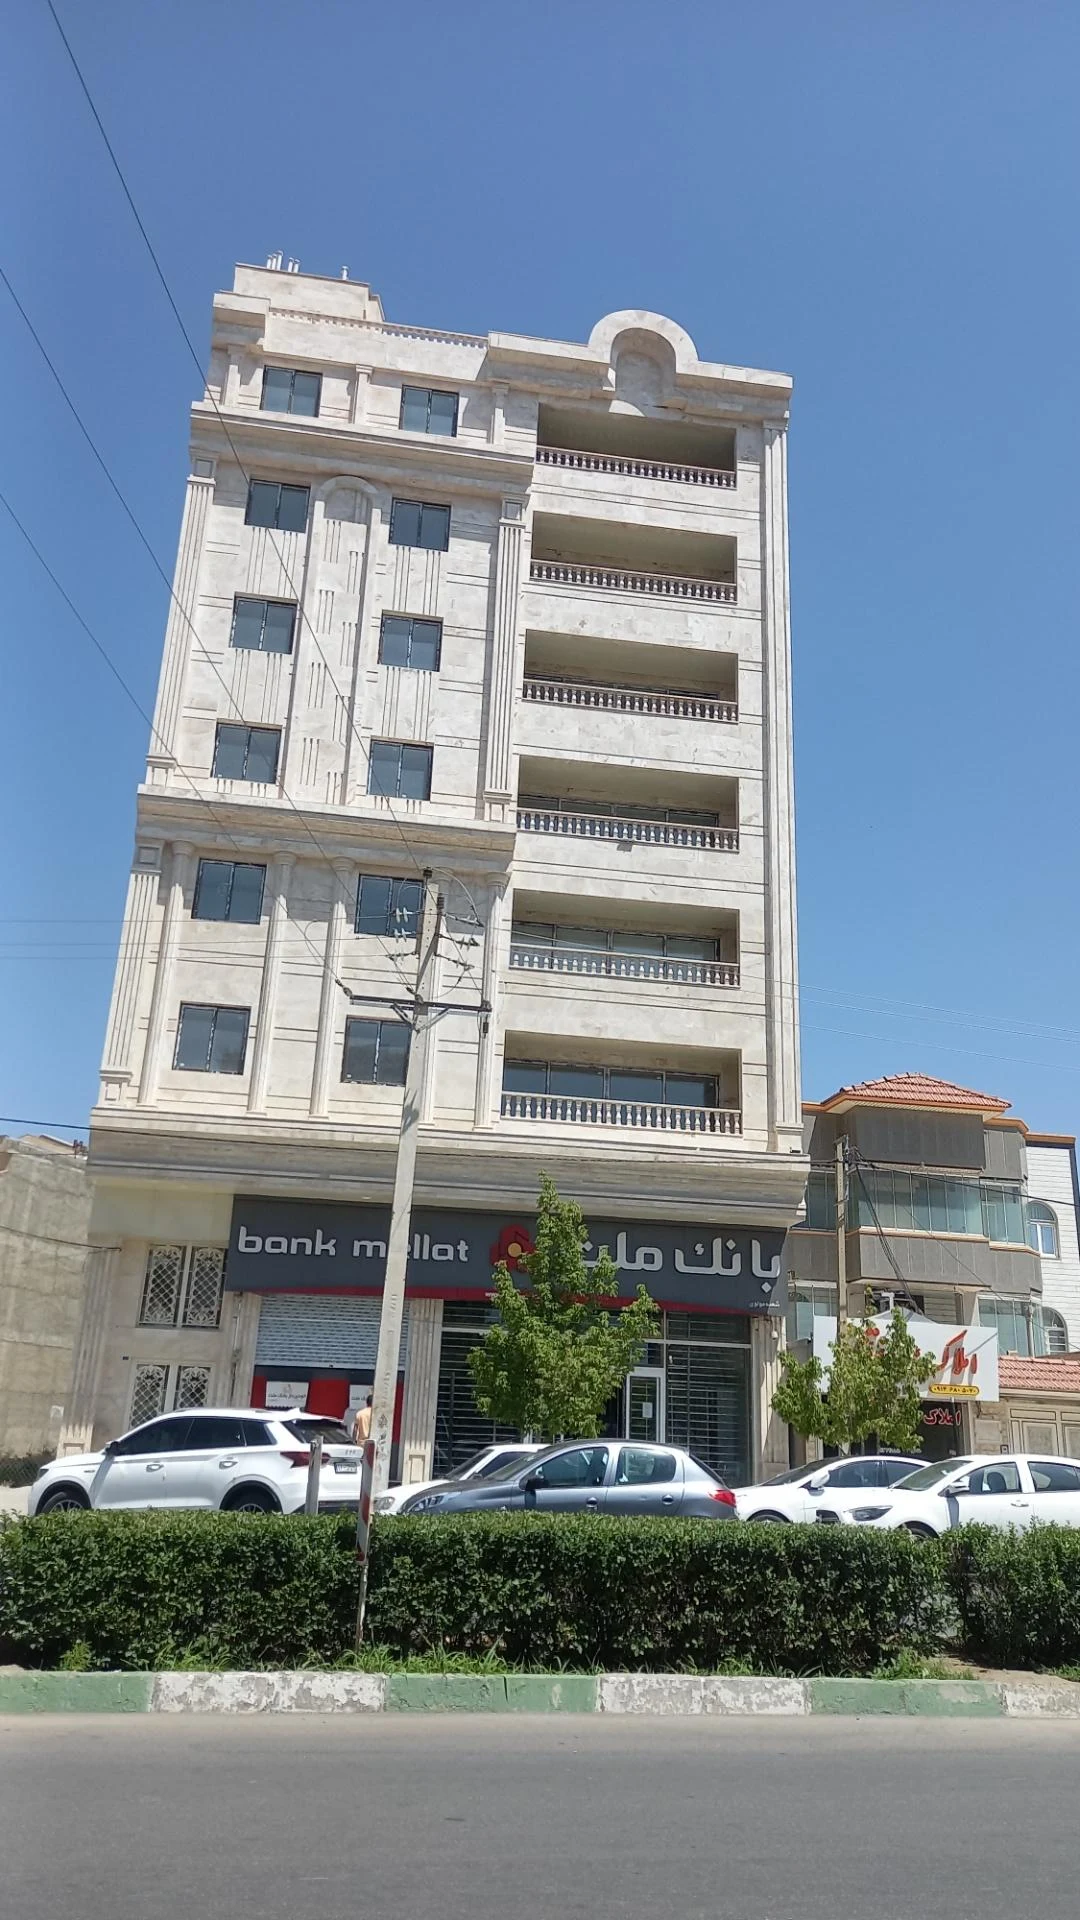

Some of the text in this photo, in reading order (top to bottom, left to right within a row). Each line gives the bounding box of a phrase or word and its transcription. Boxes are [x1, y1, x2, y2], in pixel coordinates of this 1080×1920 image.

[238, 1226, 469, 1262] bank mllat
[923, 1408, 961, 1426] املاک
